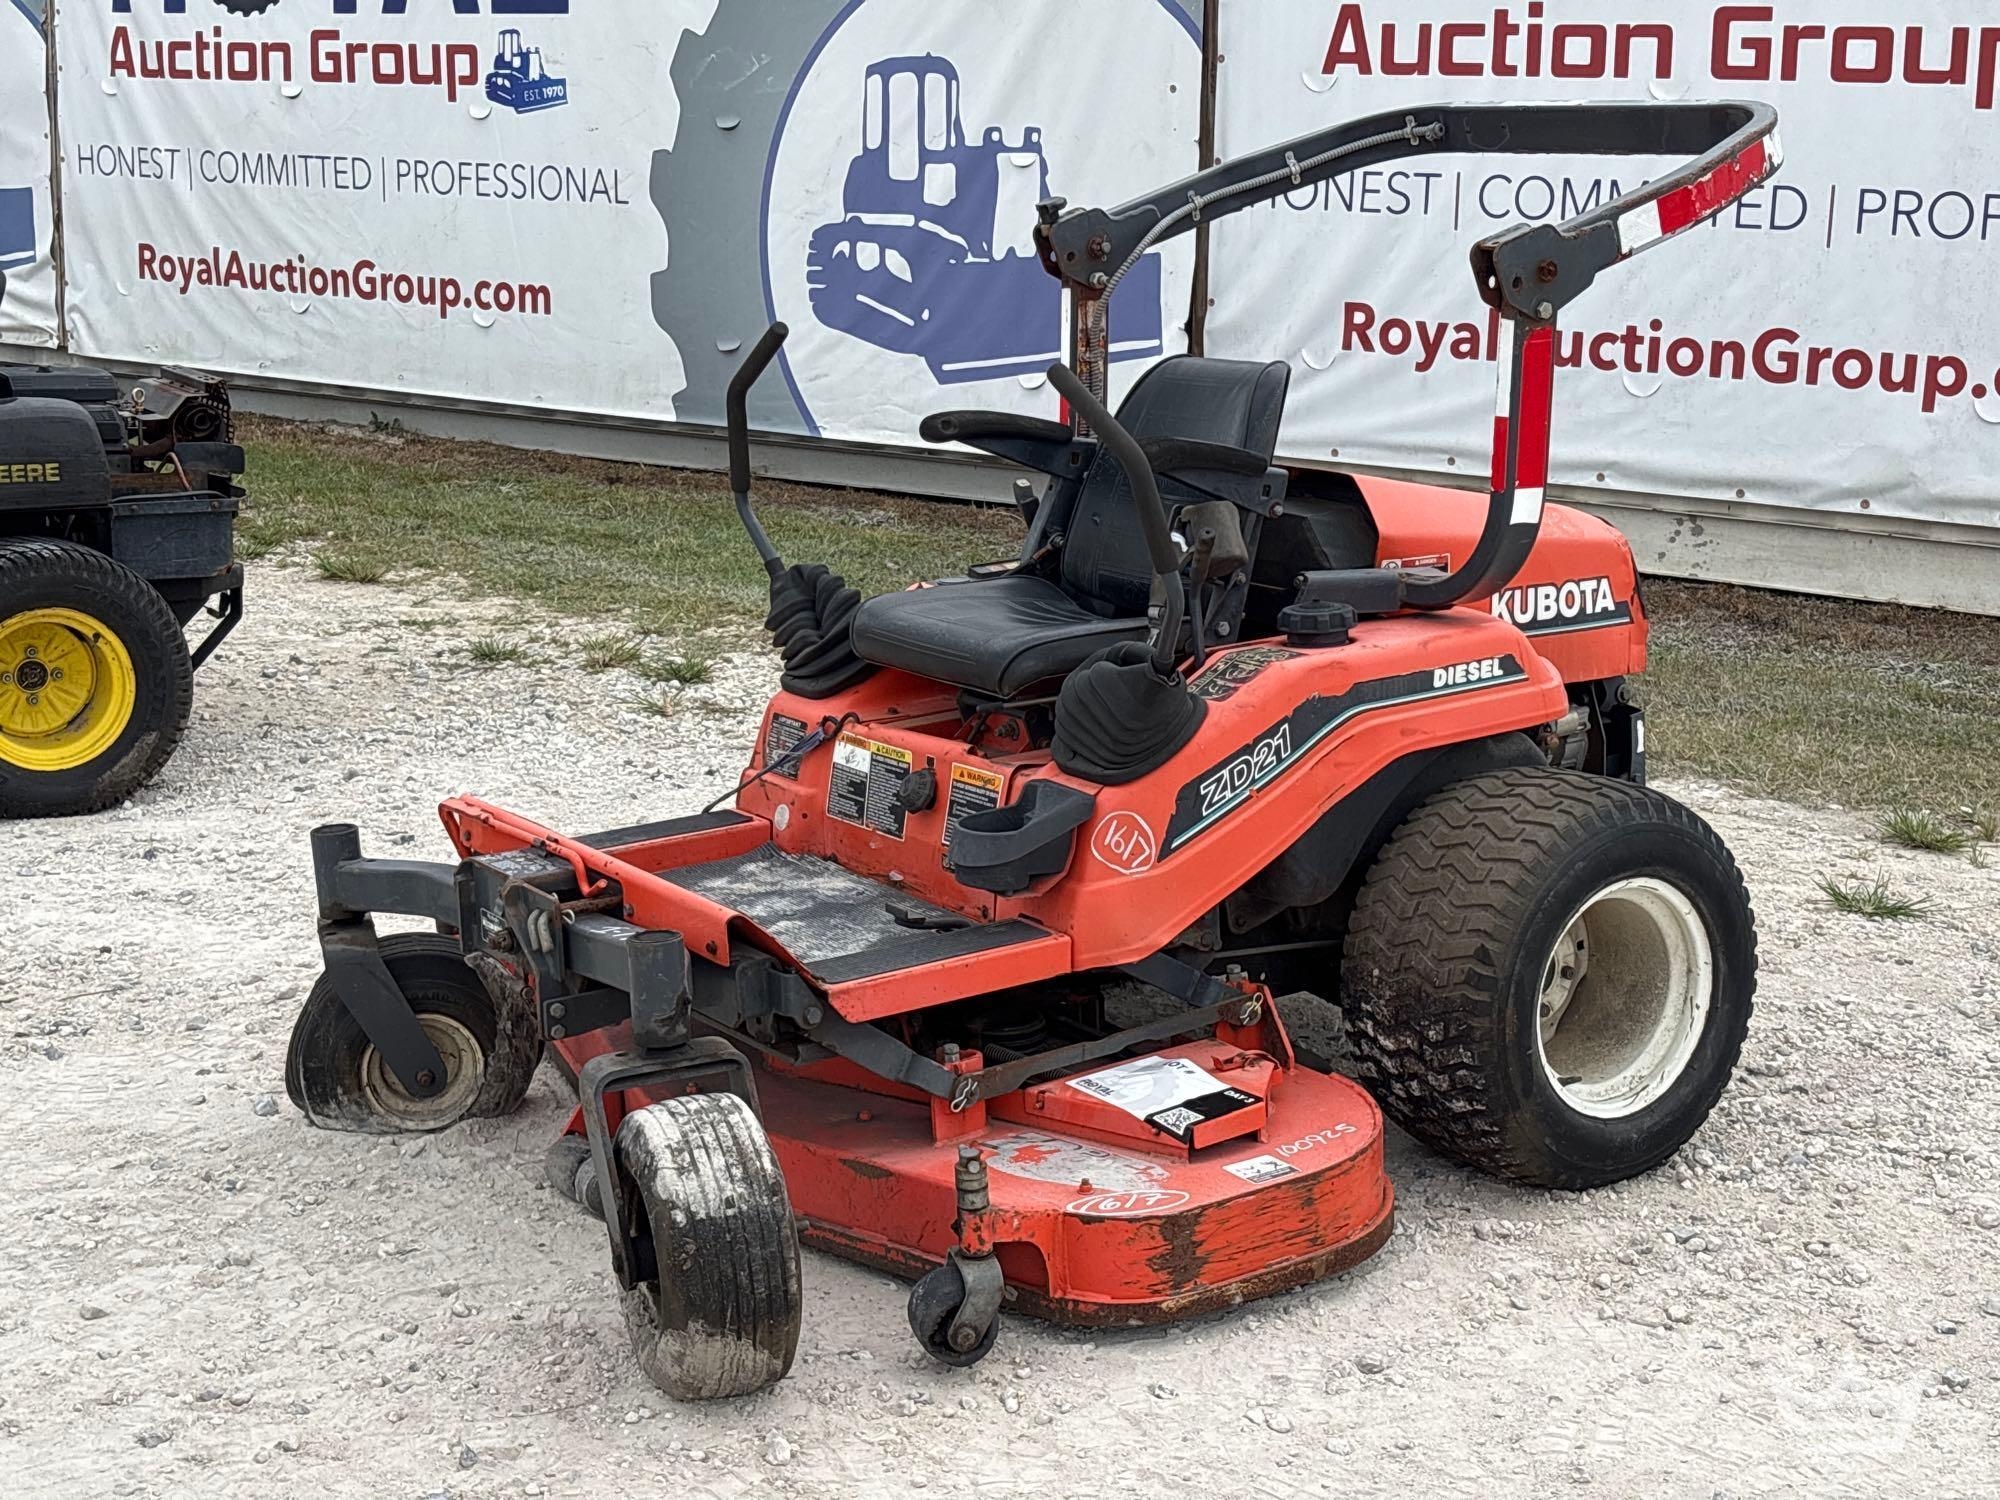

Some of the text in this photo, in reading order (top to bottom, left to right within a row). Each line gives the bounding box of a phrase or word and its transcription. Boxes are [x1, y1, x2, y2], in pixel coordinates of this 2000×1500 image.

[110, 26, 479, 103] Auction Group
[1322, 2, 1673, 78] Auction
[542, 85, 564, 99] 1970
[77, 144, 630, 205] HONEST COMMITTED PROFESSIONAL
[1250, 171, 1443, 216] ONEST
[138, 243, 552, 318] RoyalAuctionGroup.com
[1490, 577, 1616, 625] KUBOTA
[1432, 657, 1504, 690] DIESEL
[881, 745, 907, 760] CAUTION
[1200, 722, 1292, 817] ZD21
[1103, 818, 1151, 869] 1617
